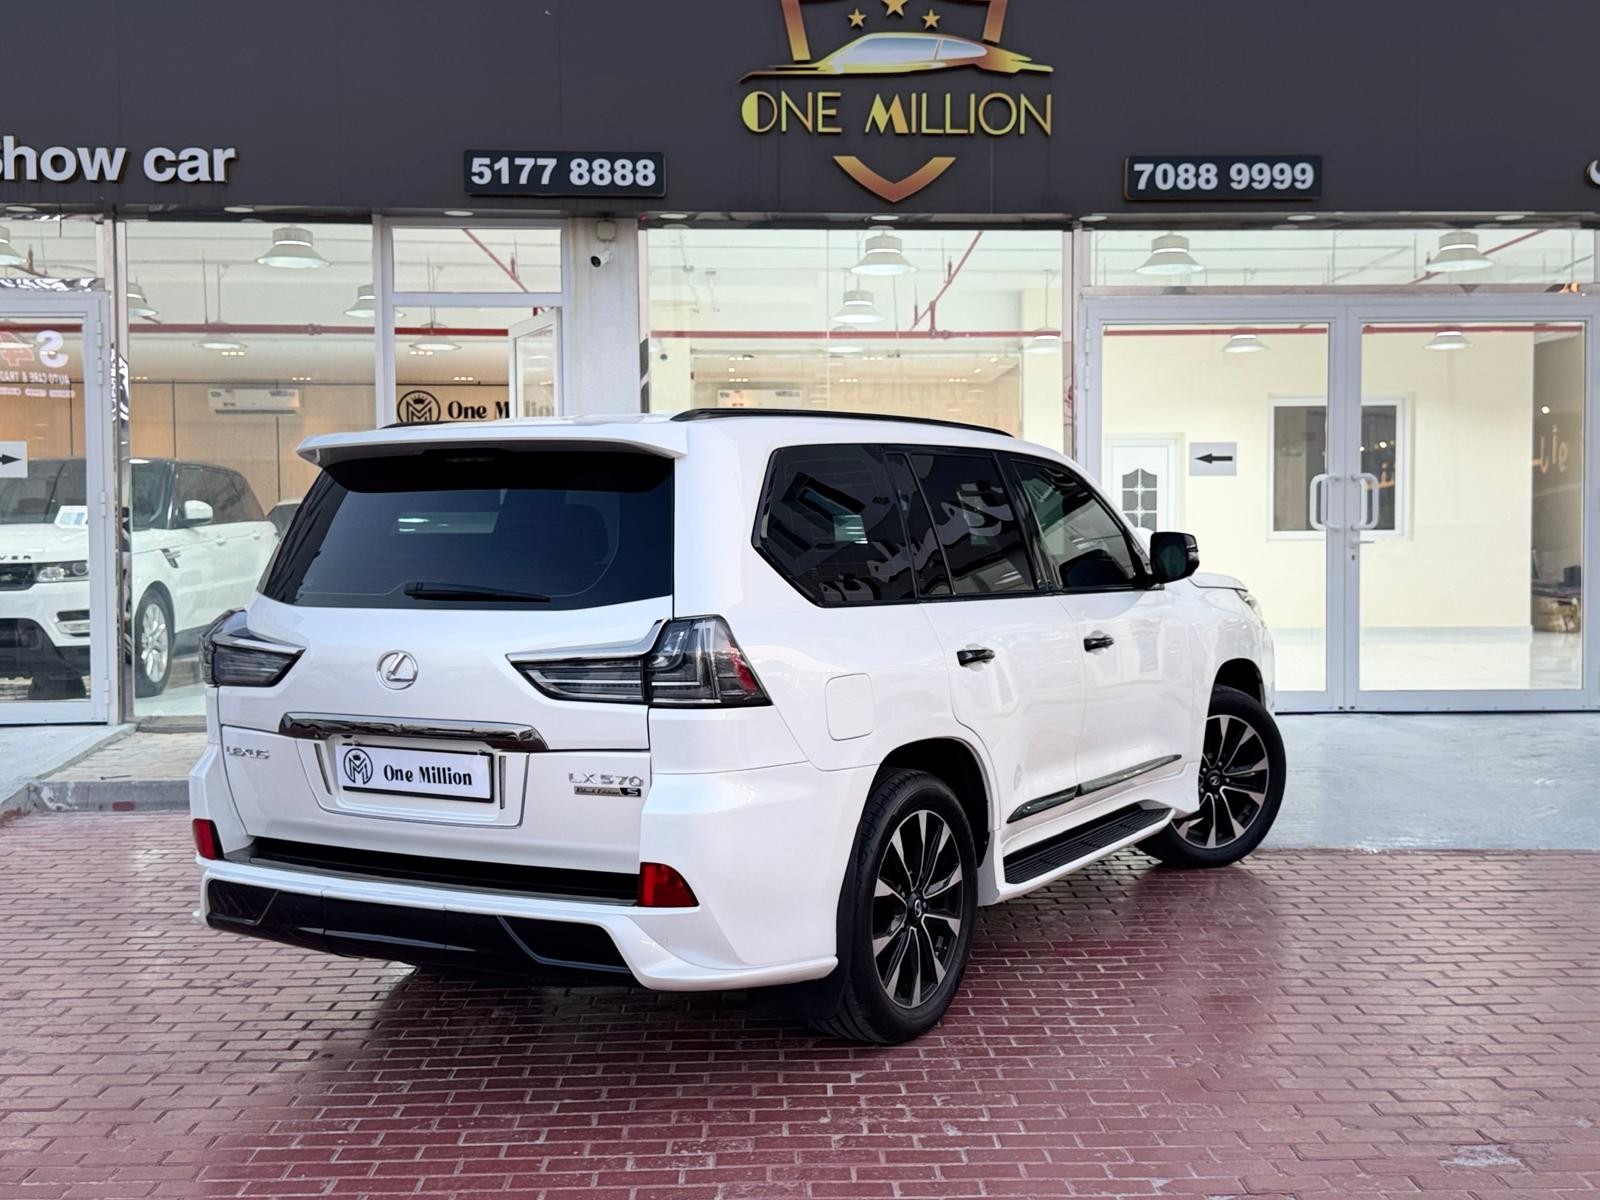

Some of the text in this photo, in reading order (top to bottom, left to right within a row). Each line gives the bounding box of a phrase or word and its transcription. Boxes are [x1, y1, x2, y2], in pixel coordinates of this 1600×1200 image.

[741, 90, 1052, 136] ONE MILLION
[0, 135, 236, 183] how car
[470, 156, 657, 187] 5177 8888
[1133, 161, 1315, 191] 7088 9999
[447, 400, 488, 419] One
[383, 764, 473, 786] One Million
[600, 774, 644, 787] 570
